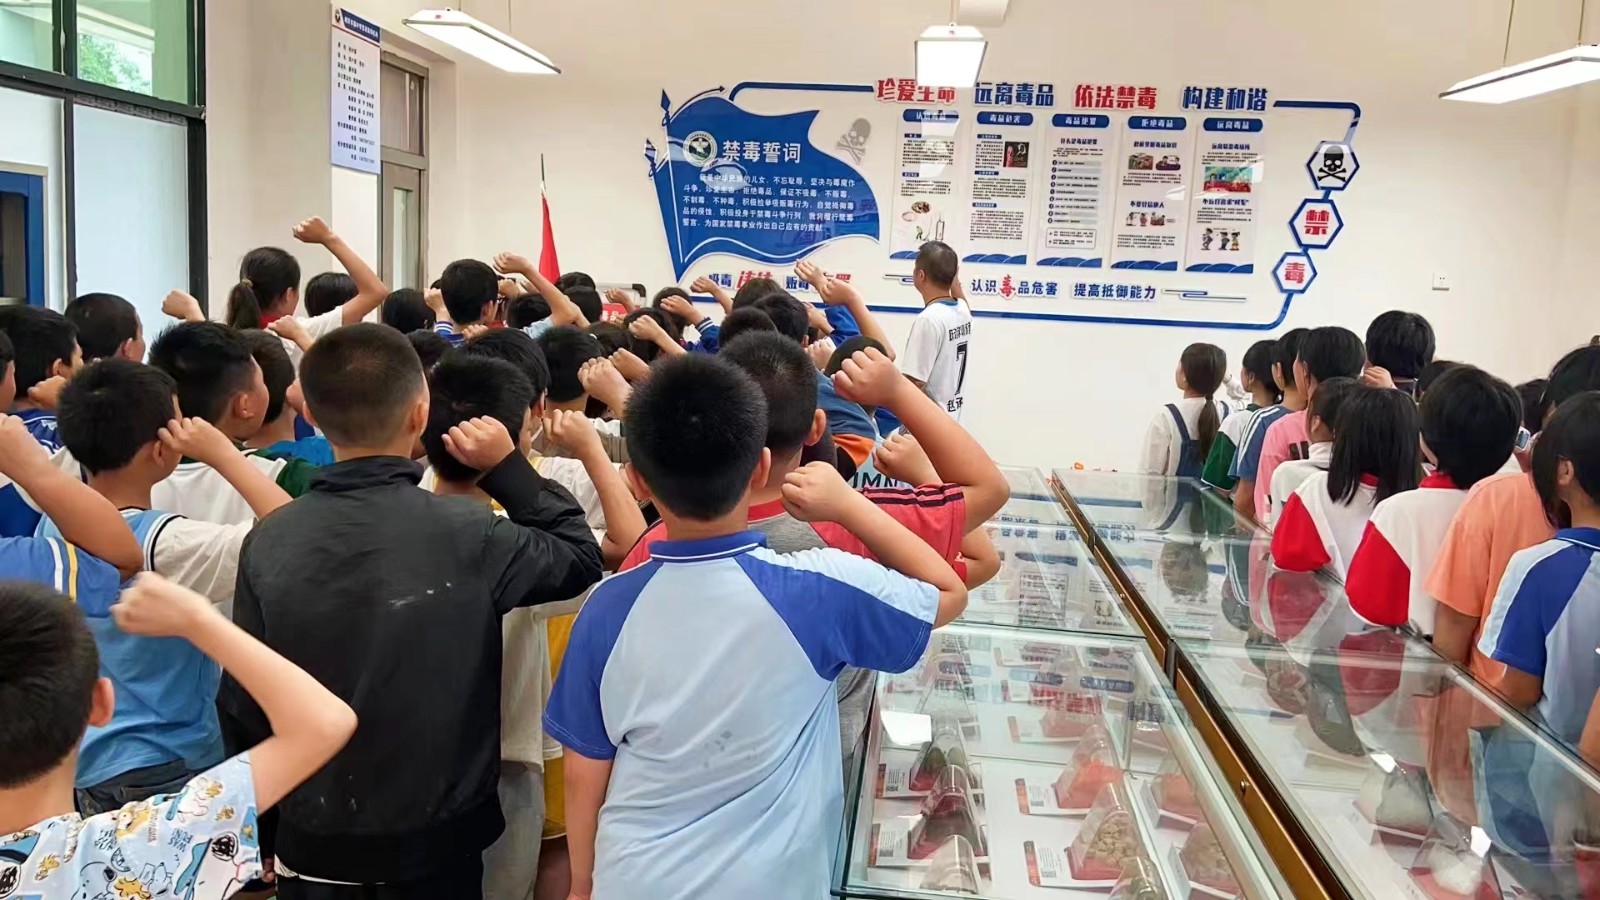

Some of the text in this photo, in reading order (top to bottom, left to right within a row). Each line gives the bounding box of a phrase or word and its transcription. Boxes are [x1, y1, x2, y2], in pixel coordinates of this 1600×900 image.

[877, 78, 1268, 111] 珍爱生命 远离毒品 依法禁毒 构建和谐
[1141, 118, 1174, 128] 拒绝毒品
[722, 140, 801, 164] 禁毒誓词
[1305, 209, 1329, 235] 禁
[708, 273, 732, 287] 吸毒
[1285, 262, 1306, 284] 毒
[1074, 282, 1156, 300] 提高抵御能力
[955, 341, 968, 396] 7
